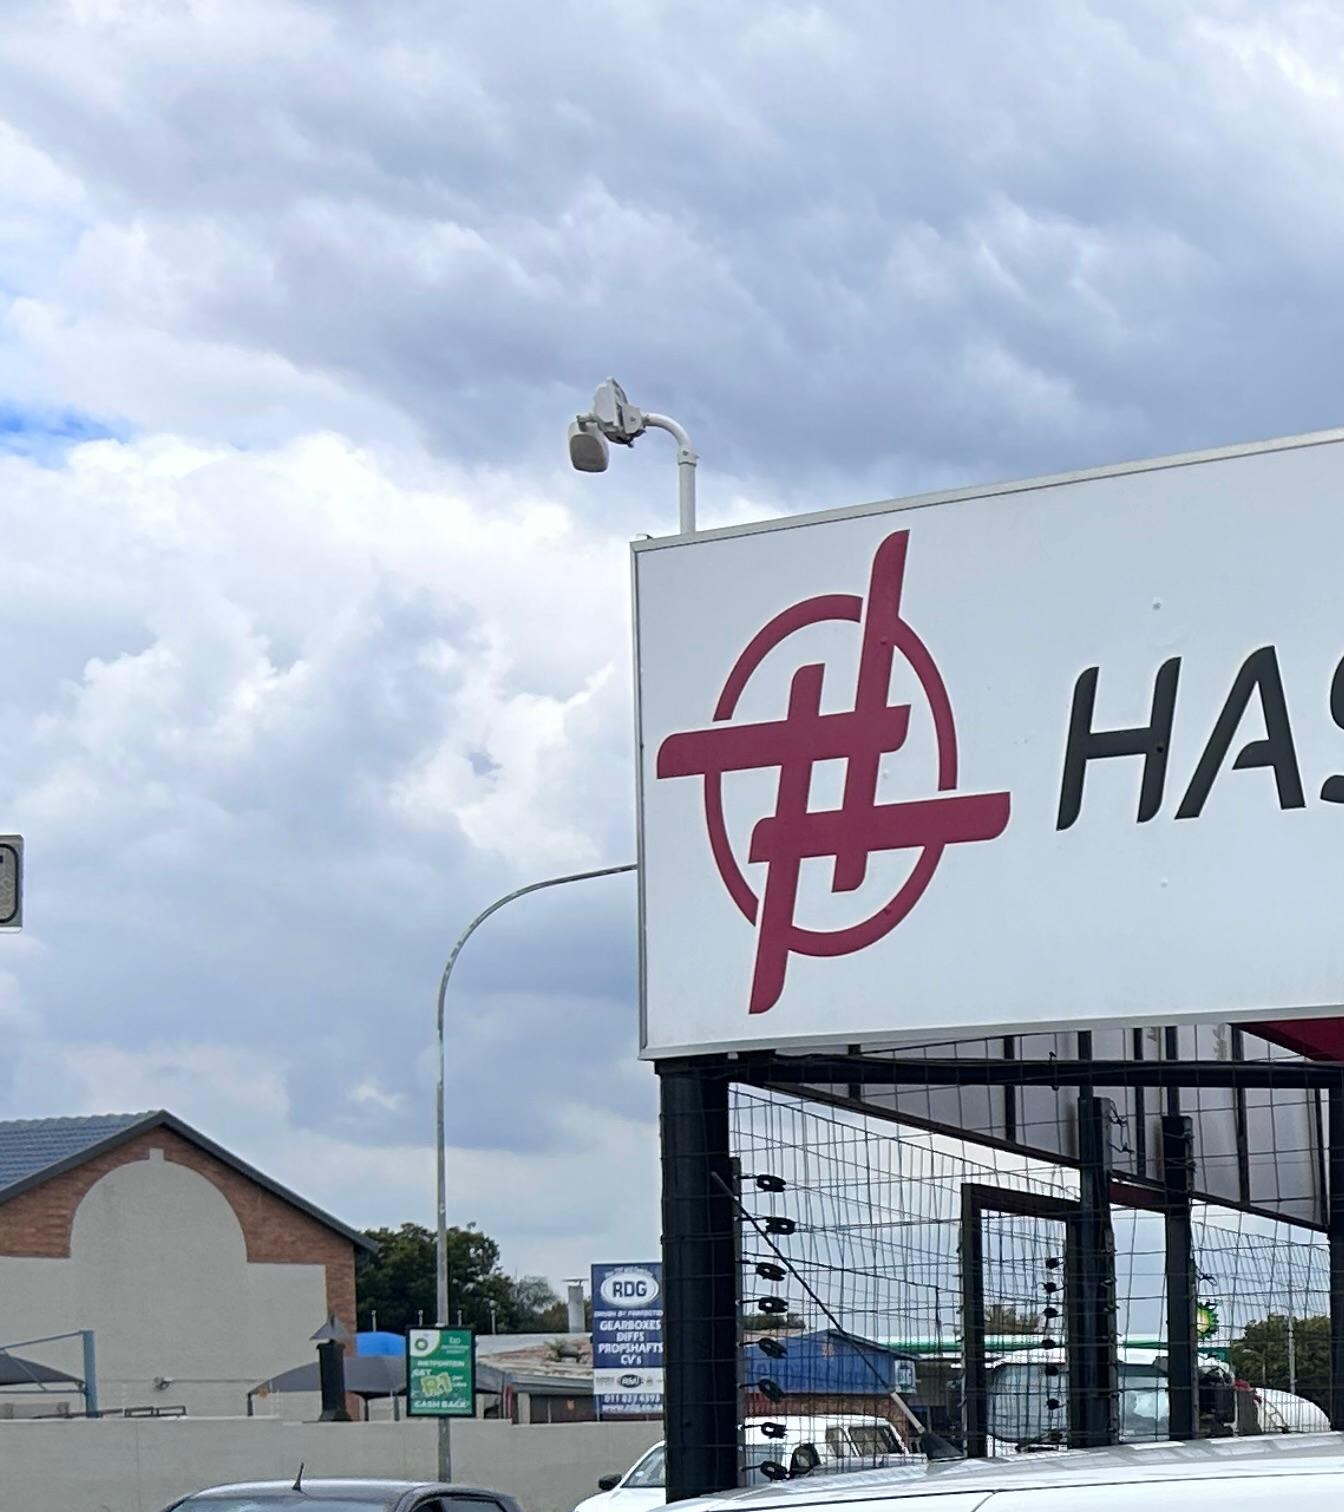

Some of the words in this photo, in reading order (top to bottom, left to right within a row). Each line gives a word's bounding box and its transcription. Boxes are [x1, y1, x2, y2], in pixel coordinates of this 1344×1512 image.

[612, 1281, 647, 1297] RDG
[600, 1320, 662, 1331] GEARBOXES
[616, 1332, 645, 1342] DIFFS
